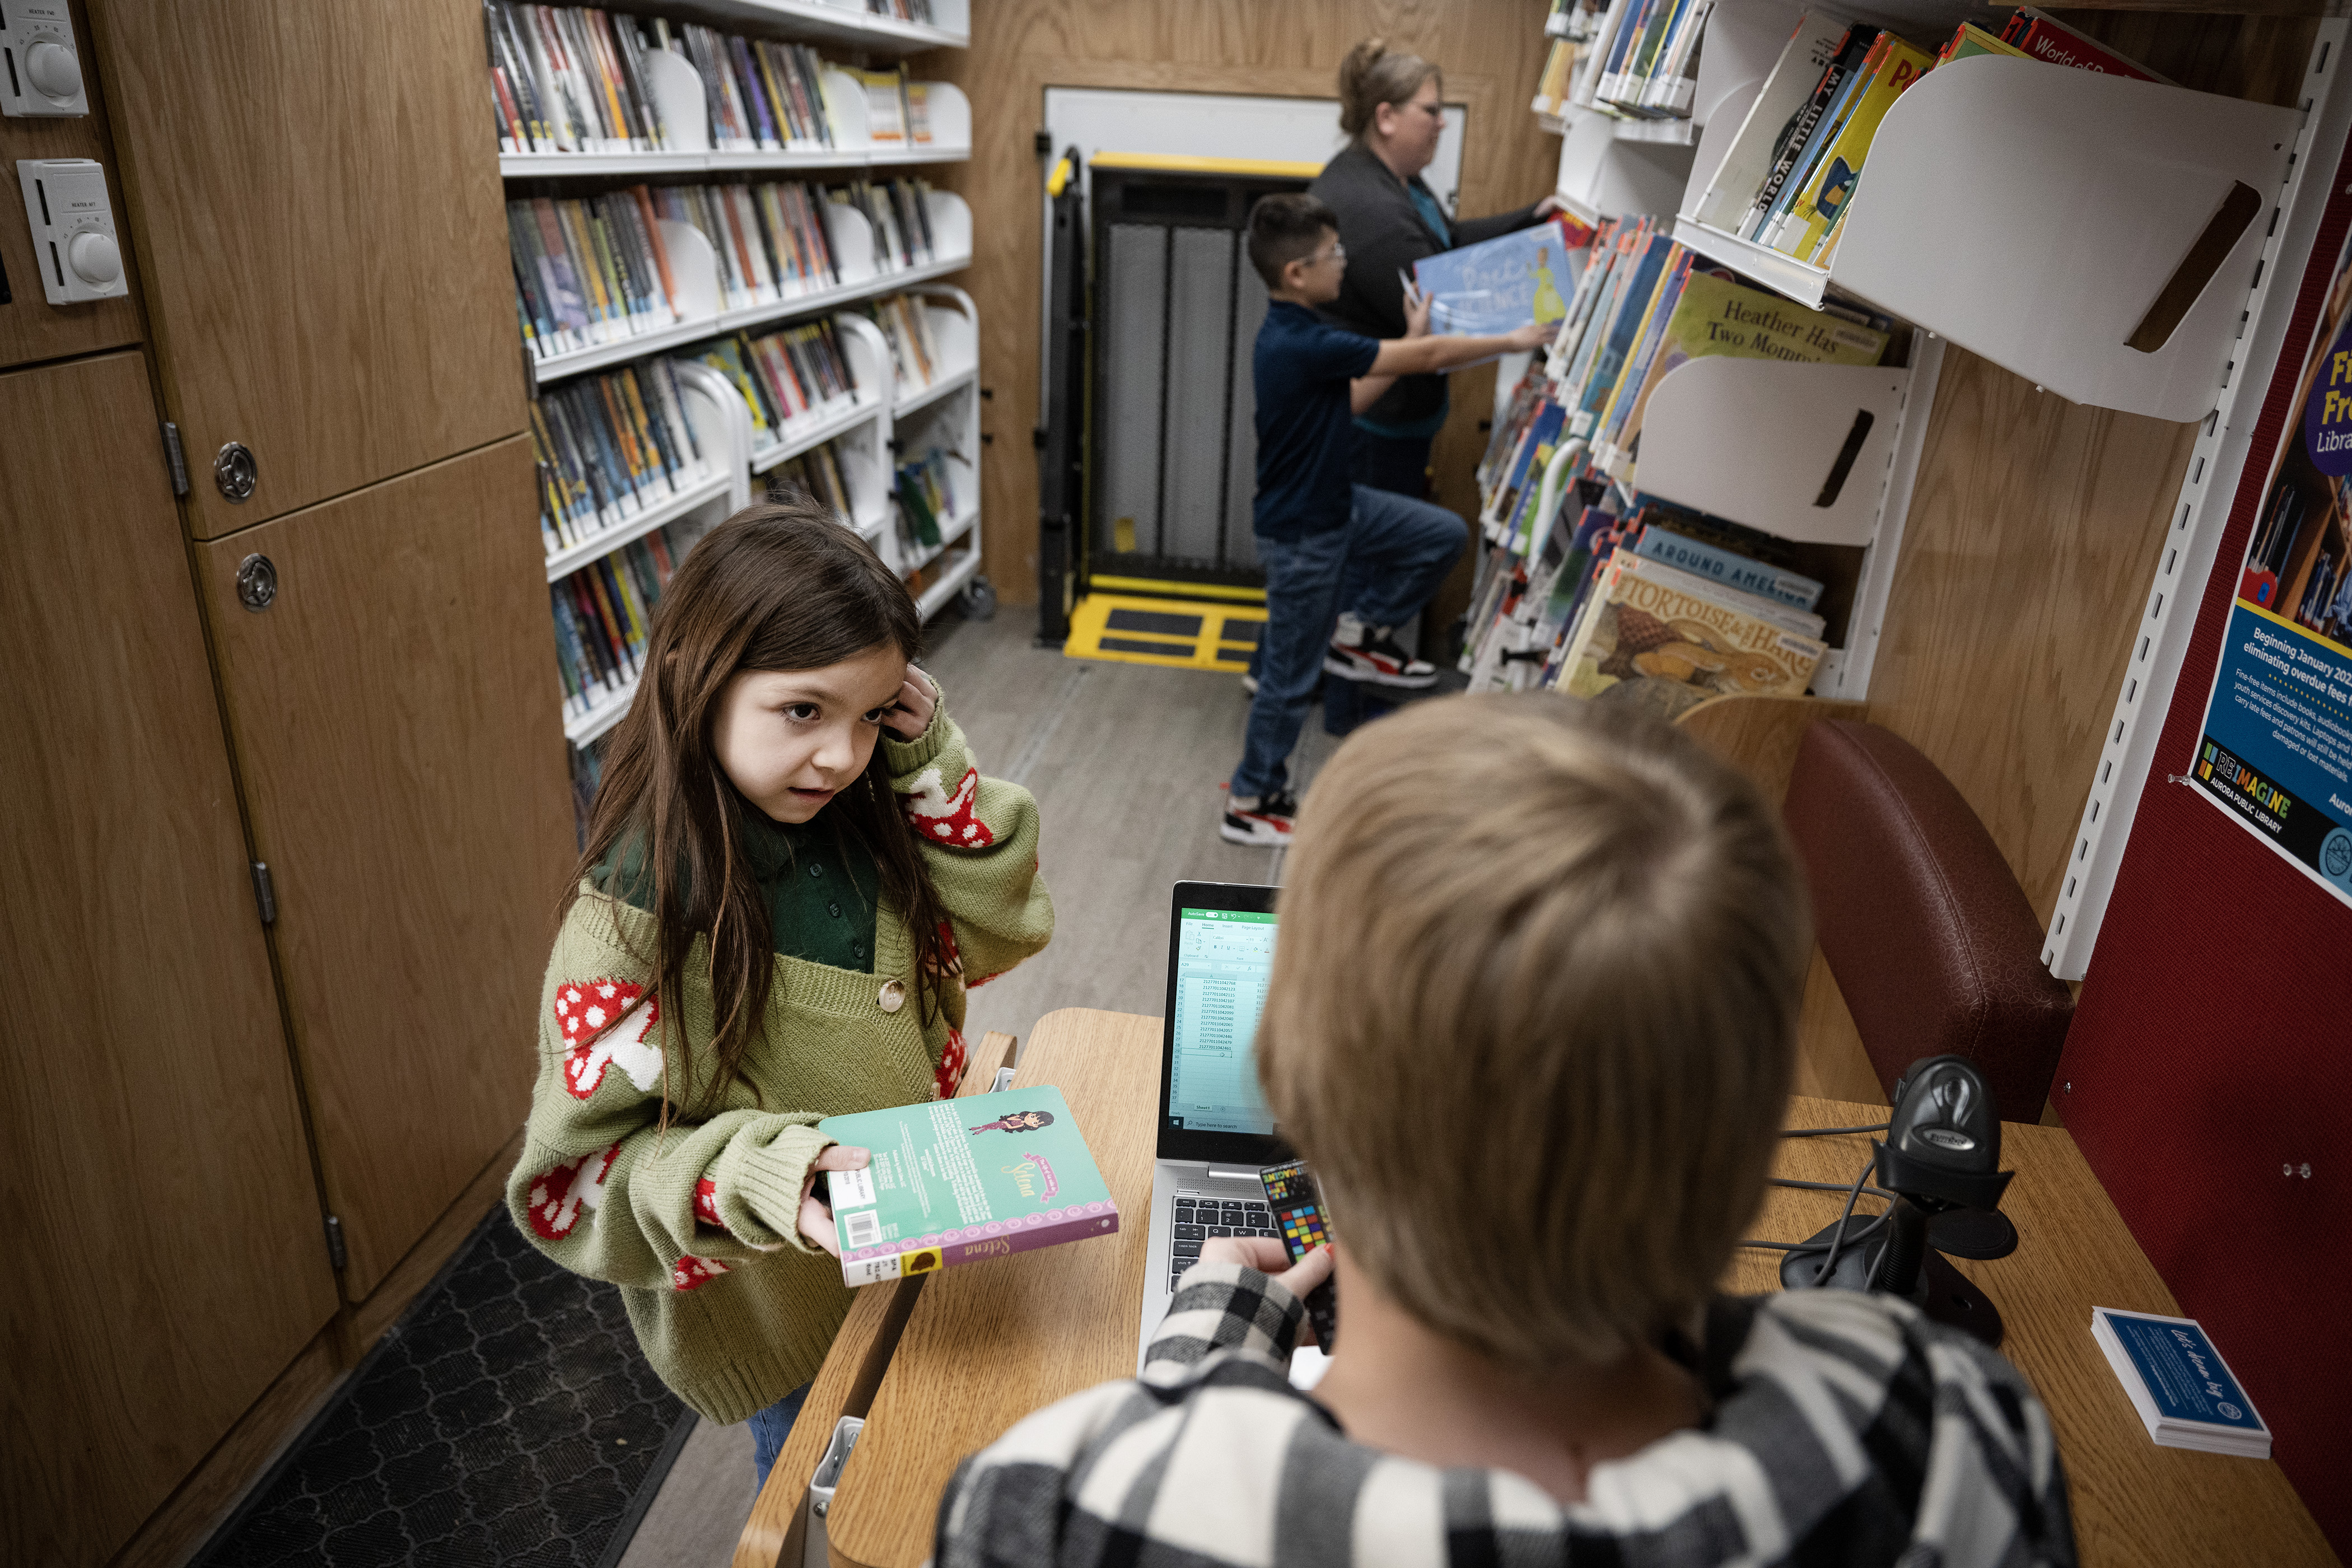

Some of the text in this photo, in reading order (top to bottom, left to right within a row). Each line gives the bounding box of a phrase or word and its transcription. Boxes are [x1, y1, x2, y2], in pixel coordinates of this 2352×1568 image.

[2034, 35, 2076, 68] World
[1824, 72, 1840, 97] MY
[1792, 104, 1822, 152] LITTLE
[1759, 160, 1792, 212] WORLD
[1707, 321, 1745, 346] Two
[1724, 301, 1803, 337] Heather
[1805, 325, 1840, 354] Has
[1653, 542, 1725, 576] AROUND
[1627, 577, 1735, 629] TORTOISE
[2243, 642, 2290, 675] eliminating
[2291, 666, 2326, 692] overdue
[2327, 683, 2348, 704] fees
[2253, 627, 2352, 688] Beginning January 202
[2234, 682, 2350, 754] youth services discovery kits. Laptops and
[2236, 668, 2260, 688] Fine-free
[2260, 681, 2276, 697] items
[2276, 690, 2298, 709] include
[2298, 702, 2316, 721] books,
[2235, 695, 2249, 708] carry
[2249, 701, 2260, 713] late
[2260, 708, 2271, 721] fees
[2271, 716, 2284, 727] and
[2283, 722, 2306, 741] patrons
[2306, 736, 2318, 748] will
[2317, 743, 2329, 755] still
[2328, 749, 2337, 760] be
[2272, 730, 2348, 783] damaged or lost materials.
[2210, 777, 2282, 834] AURORA PUBLIC LIBRARY
[2216, 752, 2291, 819] REIMAGINE
[1001, 1161, 1037, 1198] Selena
[965, 1235, 1010, 1257] Selena
[2171, 1329, 2224, 1399] Let's dream big
